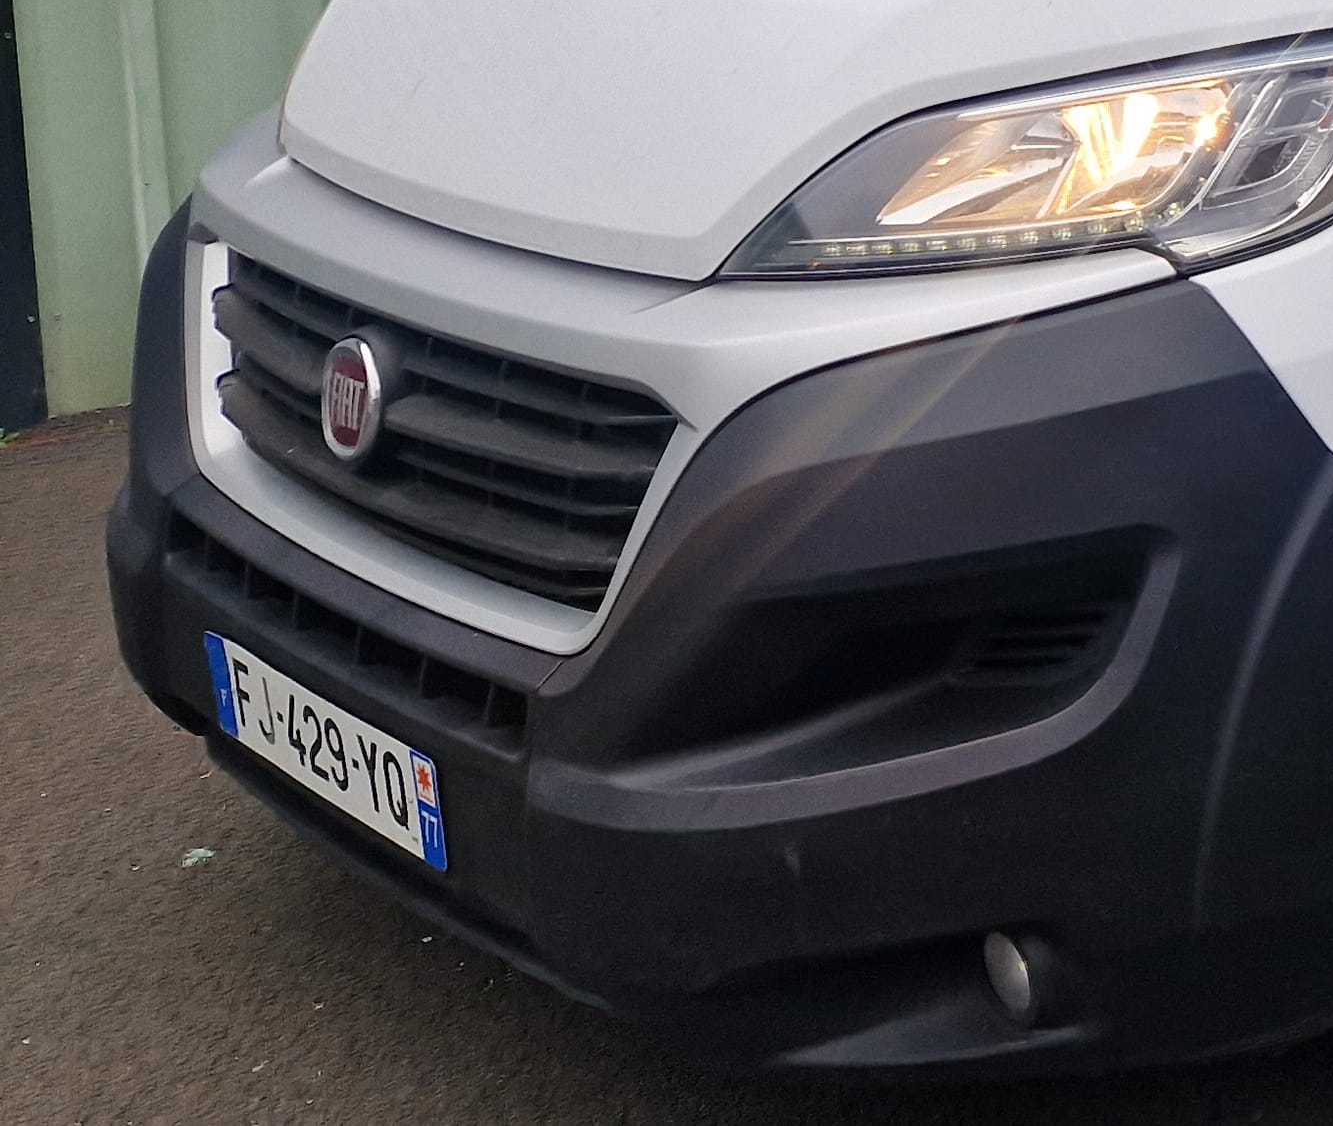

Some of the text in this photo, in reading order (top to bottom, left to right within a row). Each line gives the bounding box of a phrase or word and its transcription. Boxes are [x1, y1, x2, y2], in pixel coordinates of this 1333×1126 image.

[331, 371, 366, 431] FIAT
[231, 657, 410, 831] FJ-429-YQ
[421, 810, 438, 849] 77
